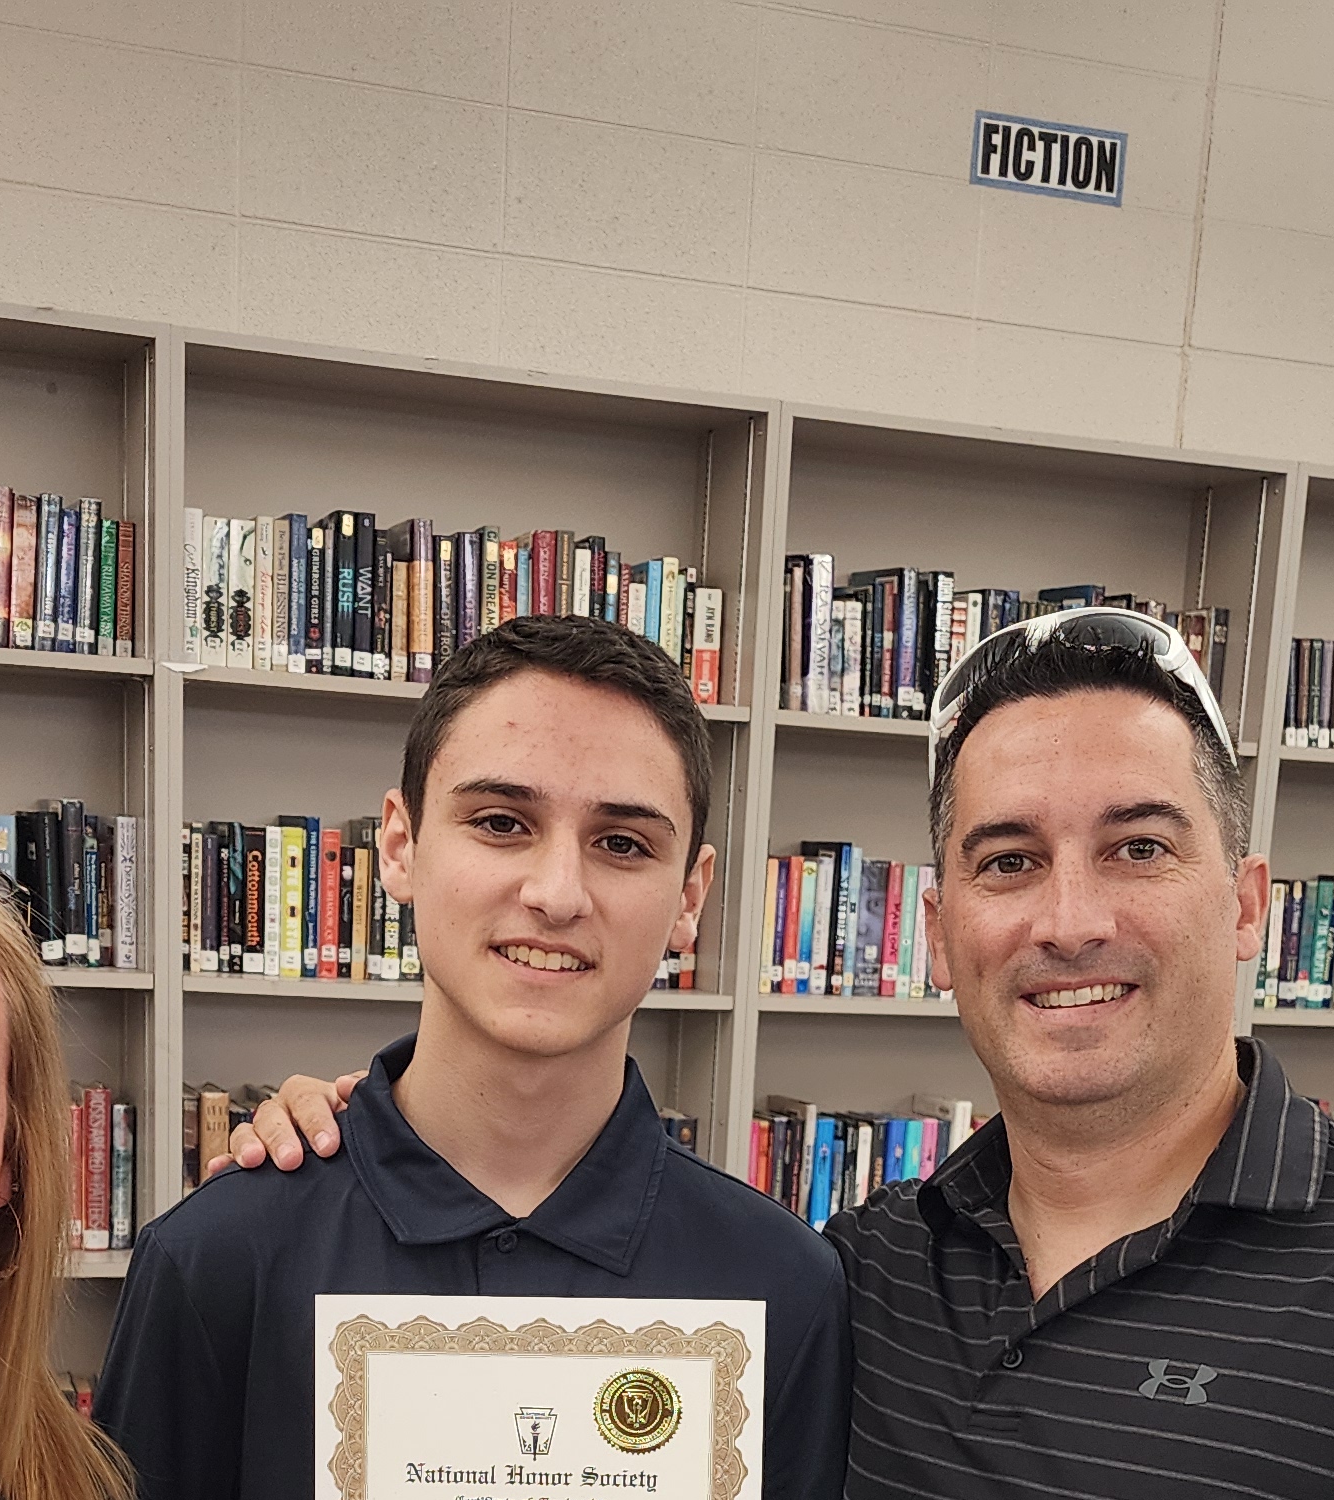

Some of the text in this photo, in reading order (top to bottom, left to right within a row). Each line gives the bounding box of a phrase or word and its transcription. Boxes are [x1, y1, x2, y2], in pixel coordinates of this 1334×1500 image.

[980, 121, 1118, 193] FICTION
[119, 562, 131, 602] SHADOW
[184, 566, 200, 619] Kingdom
[338, 568, 353, 613] RUSE
[357, 565, 373, 618] WANT
[275, 572, 287, 645] BLESSINGS
[310, 597, 321, 624] GIRLS
[705, 606, 715, 620] AYN
[246, 850, 263, 947] Cottonmouth
[88, 1182, 105, 1230] PATTERS
[405, 1463, 658, 1492] National Honor Society
